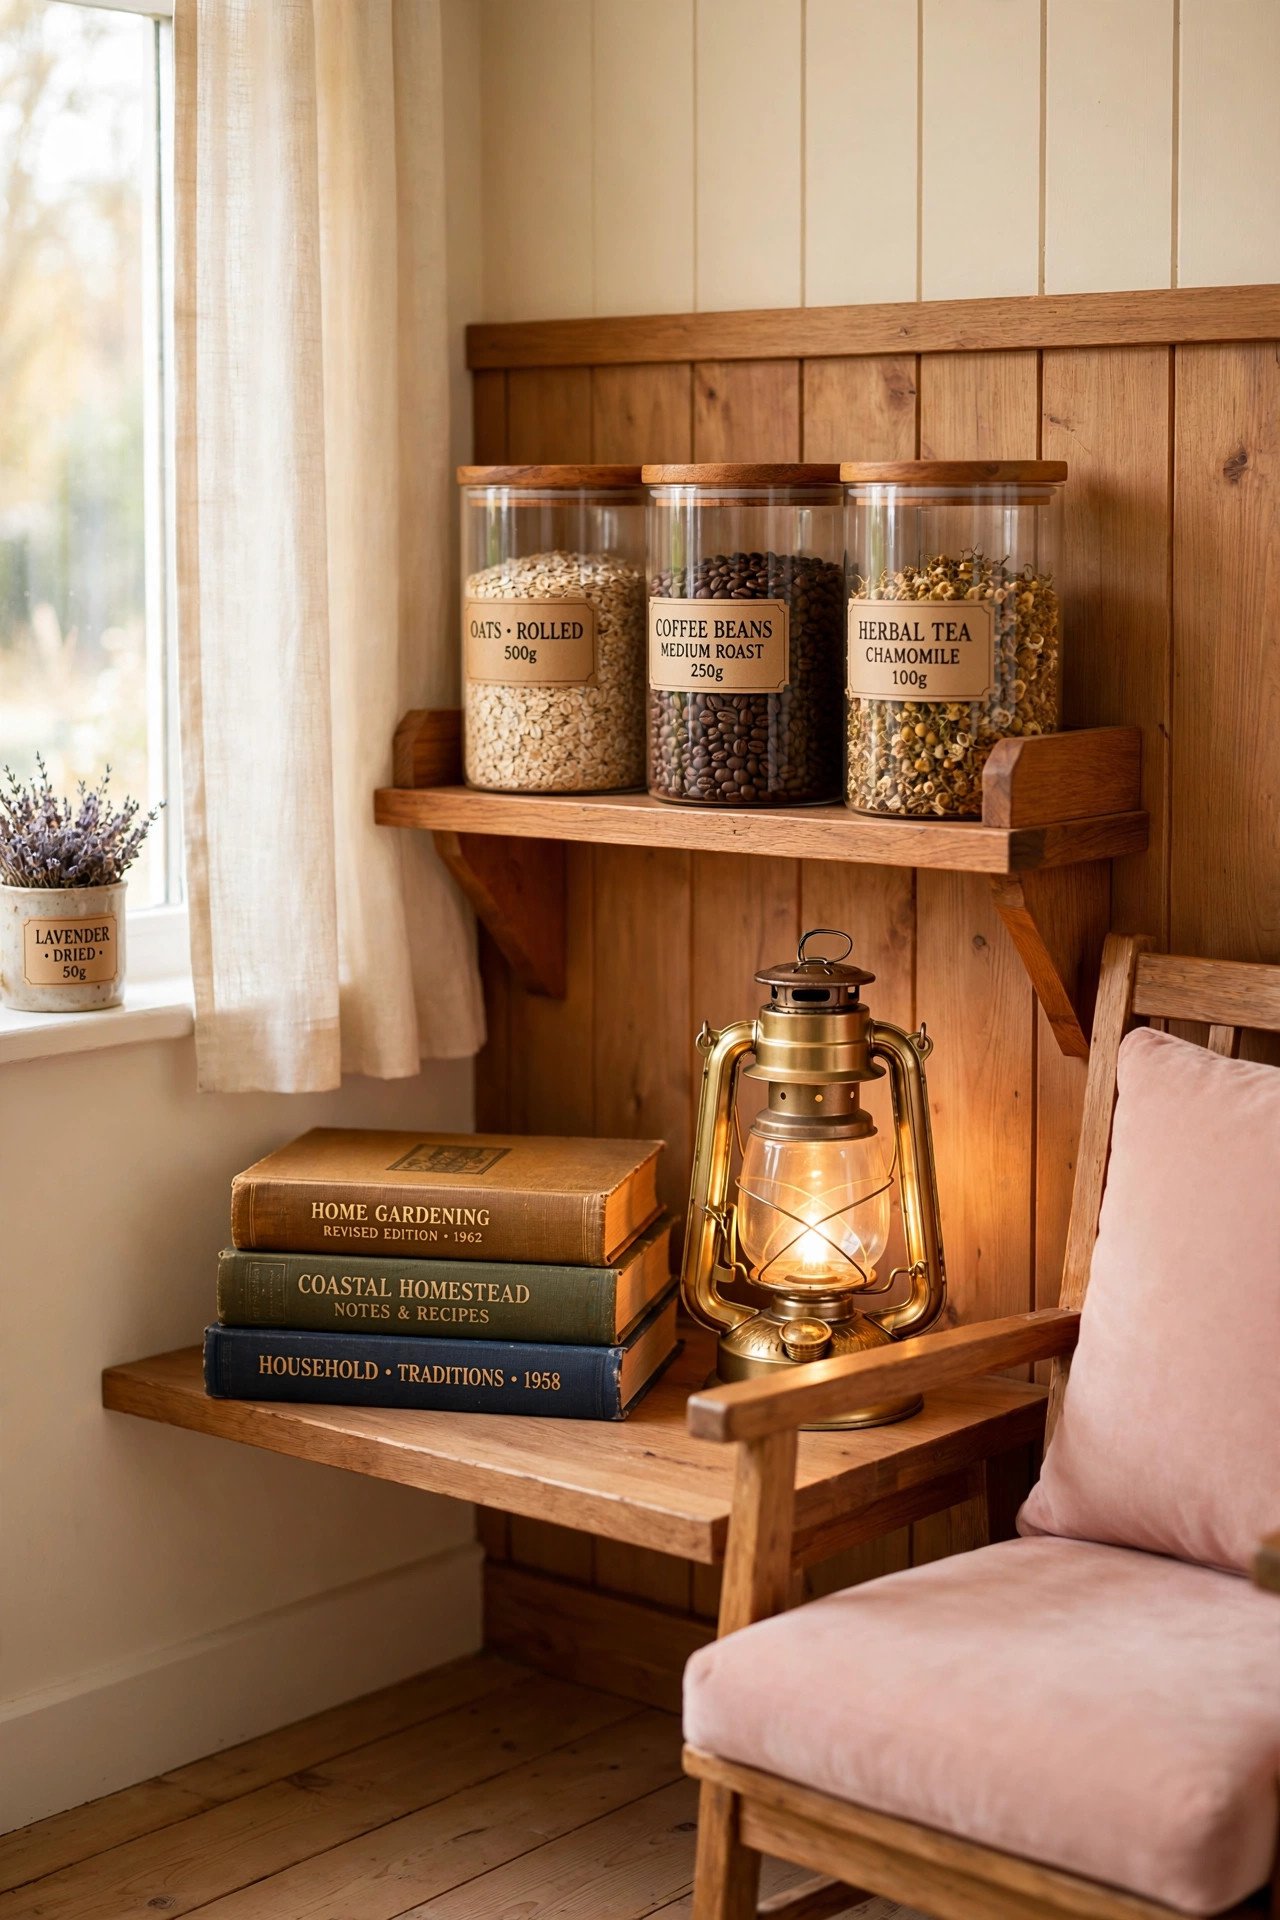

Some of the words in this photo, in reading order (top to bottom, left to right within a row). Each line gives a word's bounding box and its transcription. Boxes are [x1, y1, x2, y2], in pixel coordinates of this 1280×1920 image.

[470, 620, 502, 639] OATS
[517, 621, 584, 640] ROLLED
[655, 618, 708, 639] COFFEE
[713, 620, 773, 639] BEANS
[858, 620, 925, 642] HERBAL
[931, 622, 973, 642] TEA
[504, 646, 537, 664] 500g
[660, 642, 711, 659] MEDIUM
[715, 643, 764, 660] ROAST
[865, 646, 960, 665] CHAMOMILE
[690, 663, 724, 682] 250g
[892, 670, 928, 690] 100g
[35, 926, 110, 945] LAVENDER
[53, 947, 96, 962] DRIED
[62, 965, 87, 981] 50g
[311, 1202, 367, 1221] HOME
[374, 1204, 491, 1226] GARDENING
[323, 1225, 379, 1239] REVISED
[383, 1227, 438, 1242] EDITION
[453, 1231, 483, 1243] 1962
[298, 1274, 392, 1298] COASTAL
[399, 1278, 530, 1305] HOMESTEAD
[334, 1302, 390, 1319] NOTES
[397, 1305, 410, 1320] &
[417, 1306, 490, 1324] RECIPES
[258, 1354, 379, 1381] HOUSEHOLD
[397, 1363, 504, 1388] TRADITIONS
[523, 1370, 561, 1391] 1958
